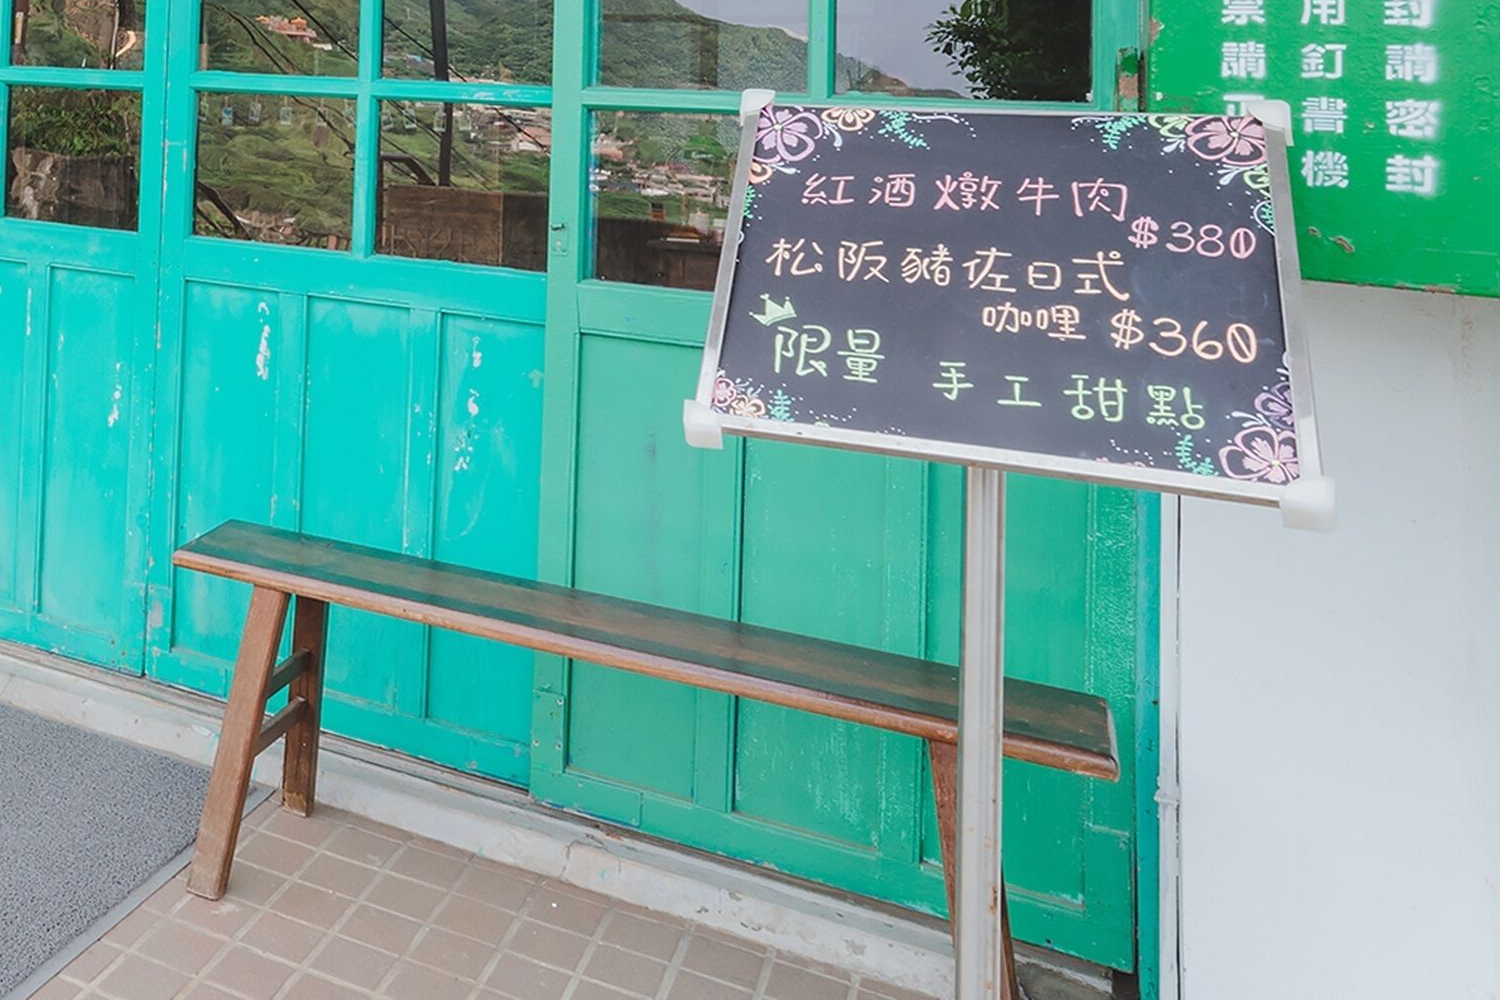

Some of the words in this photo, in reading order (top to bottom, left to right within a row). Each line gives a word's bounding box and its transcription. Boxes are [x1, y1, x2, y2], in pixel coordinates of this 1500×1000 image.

[801, 171, 1129, 222] 紅酒燉牛肉
[1127, 215, 1257, 261] $380
[764, 236, 1131, 302] 松阪豬佐日式
[772, 325, 886, 385] 限量
[981, 303, 1087, 342] 咖哩
[1109, 308, 1258, 366] $360
